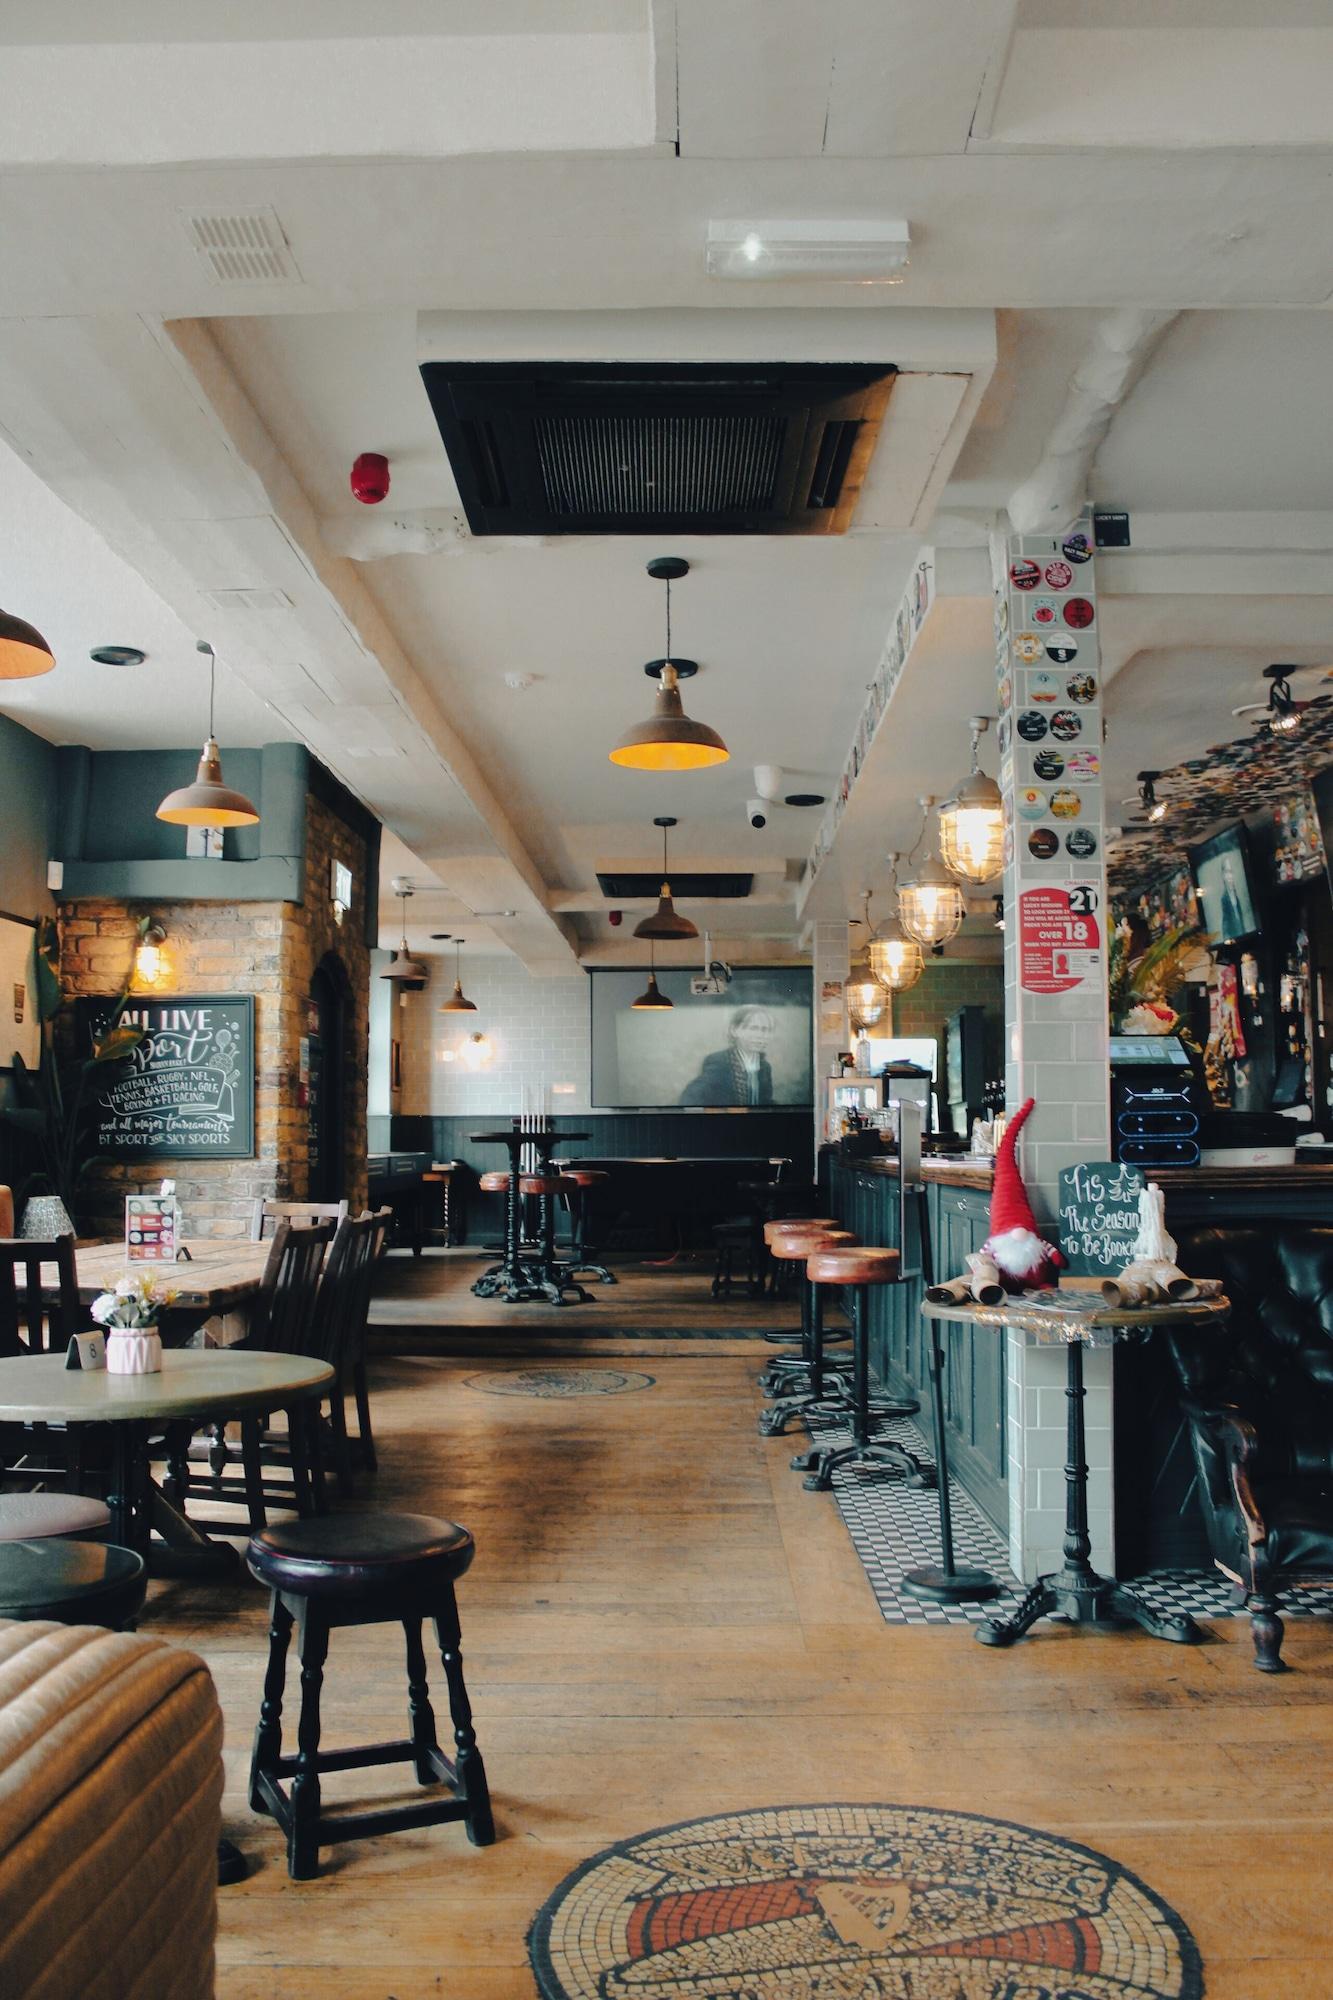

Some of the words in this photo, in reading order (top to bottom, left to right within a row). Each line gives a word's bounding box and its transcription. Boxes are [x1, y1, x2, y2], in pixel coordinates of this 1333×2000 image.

[1069, 889, 1097, 911] 21
[1038, 931, 1063, 939] OVER
[1063, 922, 1089, 940] 18
[161, 1009, 213, 1031] LIVE
[130, 1029, 212, 1071] port
[123, 1098, 153, 1111] BOXING
[172, 1092, 205, 1103] RACING
[100, 1117, 117, 1131] and
[119, 1116, 132, 1131] all
[135, 1117, 163, 1133] major
[99, 1134, 111, 1145] BT
[115, 1133, 149, 1145] SPORT
[166, 1133, 187, 1145] SKY
[188, 1133, 231, 1145] SPORTS
[1060, 1205, 1089, 1232] The
[1091, 1203, 1140, 1232] Season
[1060, 1235, 1079, 1255] To
[1081, 1233, 1100, 1257] Be
[89, 1342, 97, 1359] 8
